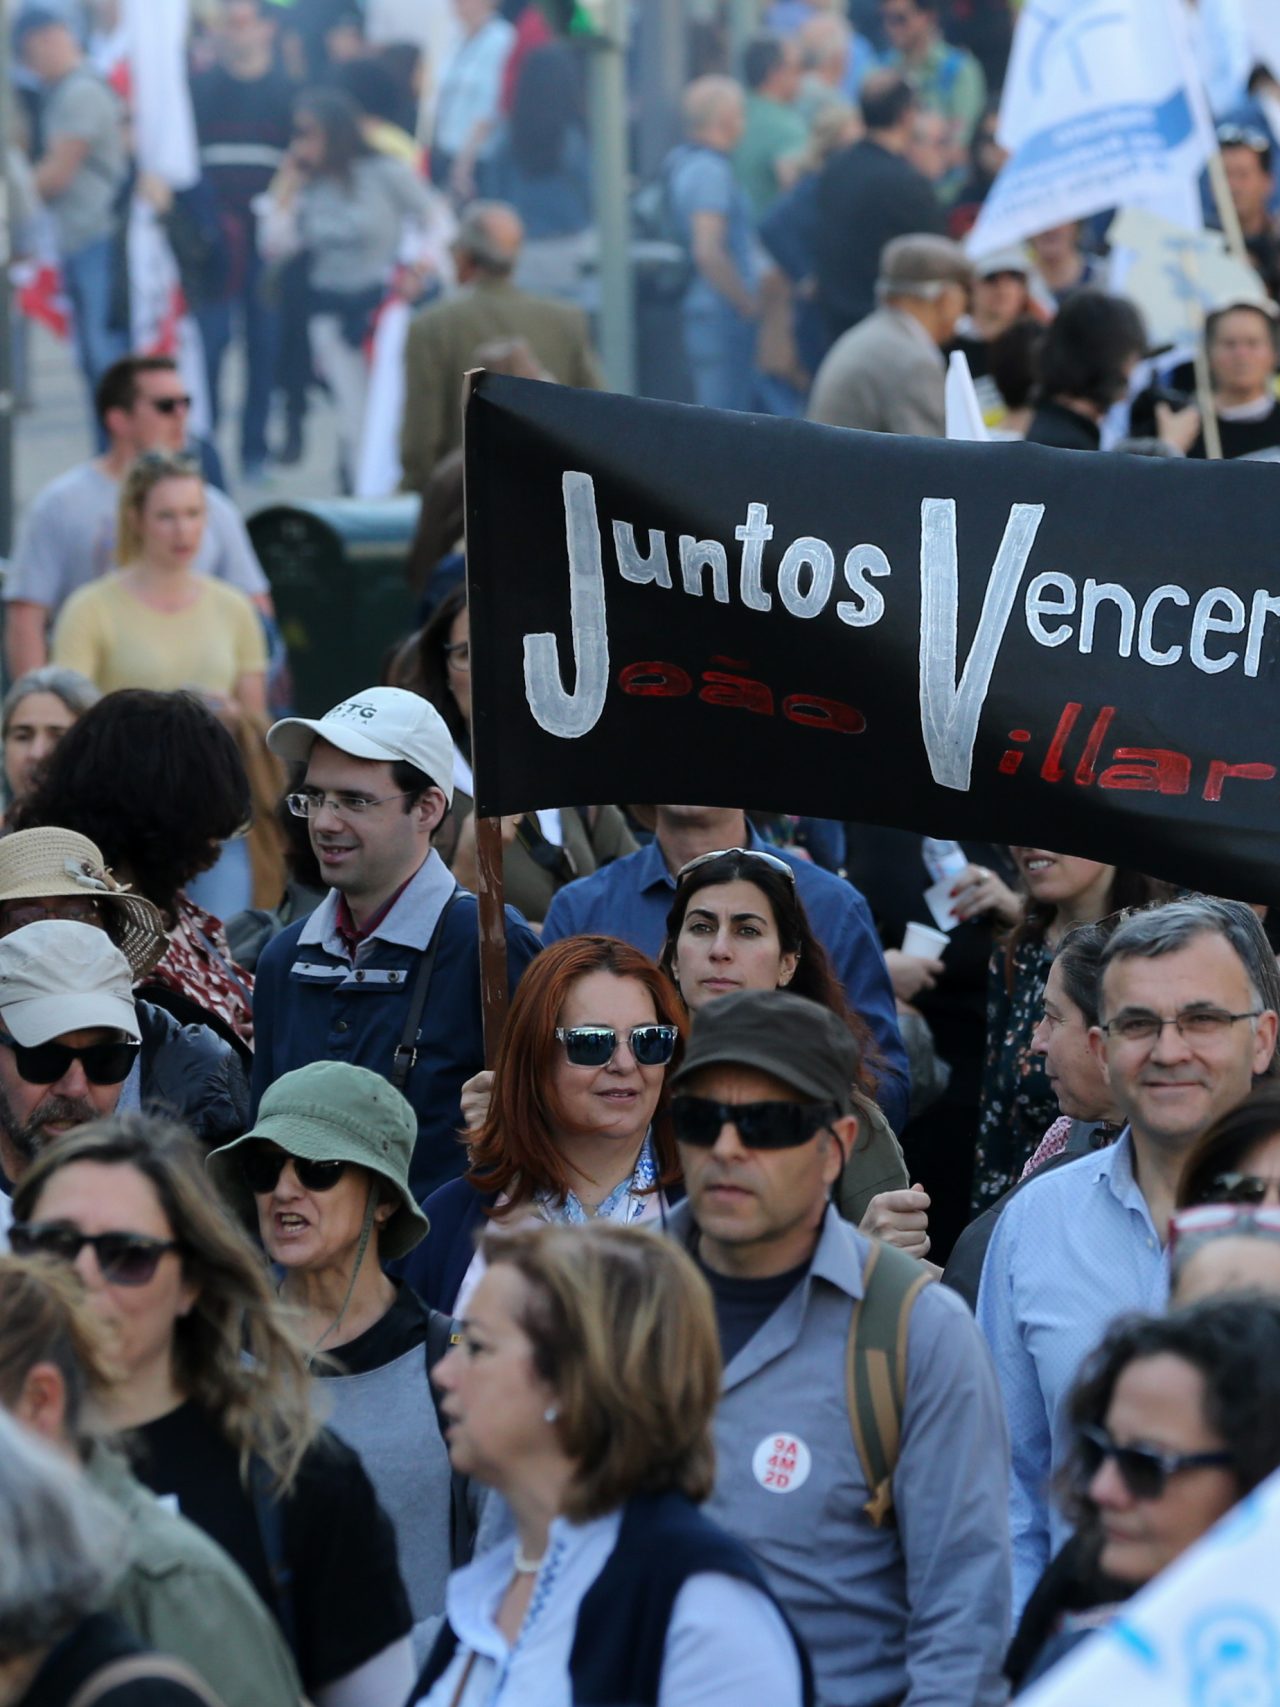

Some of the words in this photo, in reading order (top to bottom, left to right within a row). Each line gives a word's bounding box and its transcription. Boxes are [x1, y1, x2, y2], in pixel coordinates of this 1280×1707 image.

[523, 470, 891, 739] Juntos
[769, 1455, 795, 1472] 4M
[765, 1471, 790, 1488] 2D
